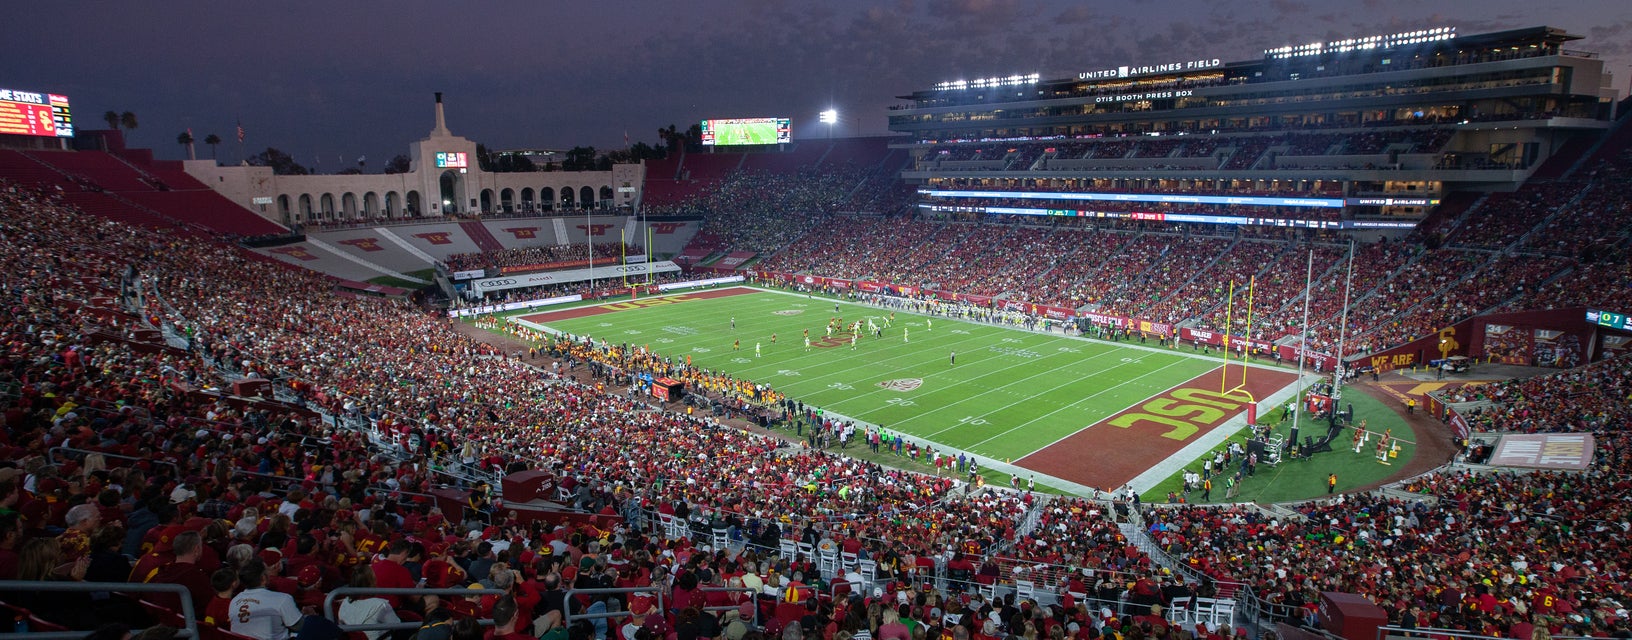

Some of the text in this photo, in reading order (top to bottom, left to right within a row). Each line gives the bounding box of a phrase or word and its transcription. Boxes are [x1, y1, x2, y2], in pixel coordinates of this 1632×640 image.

[1079, 58, 1220, 79] UNITED AIRLINES FIELD
[1146, 91, 1172, 99] PRESS
[600, 295, 703, 311] USC
[1613, 315, 1620, 324] 7
[1539, 329, 1550, 338] 11
[1371, 353, 1415, 367] WE ARE
[958, 416, 987, 425] 10
[1107, 388, 1252, 441] USC
[1544, 595, 1553, 607] 6
